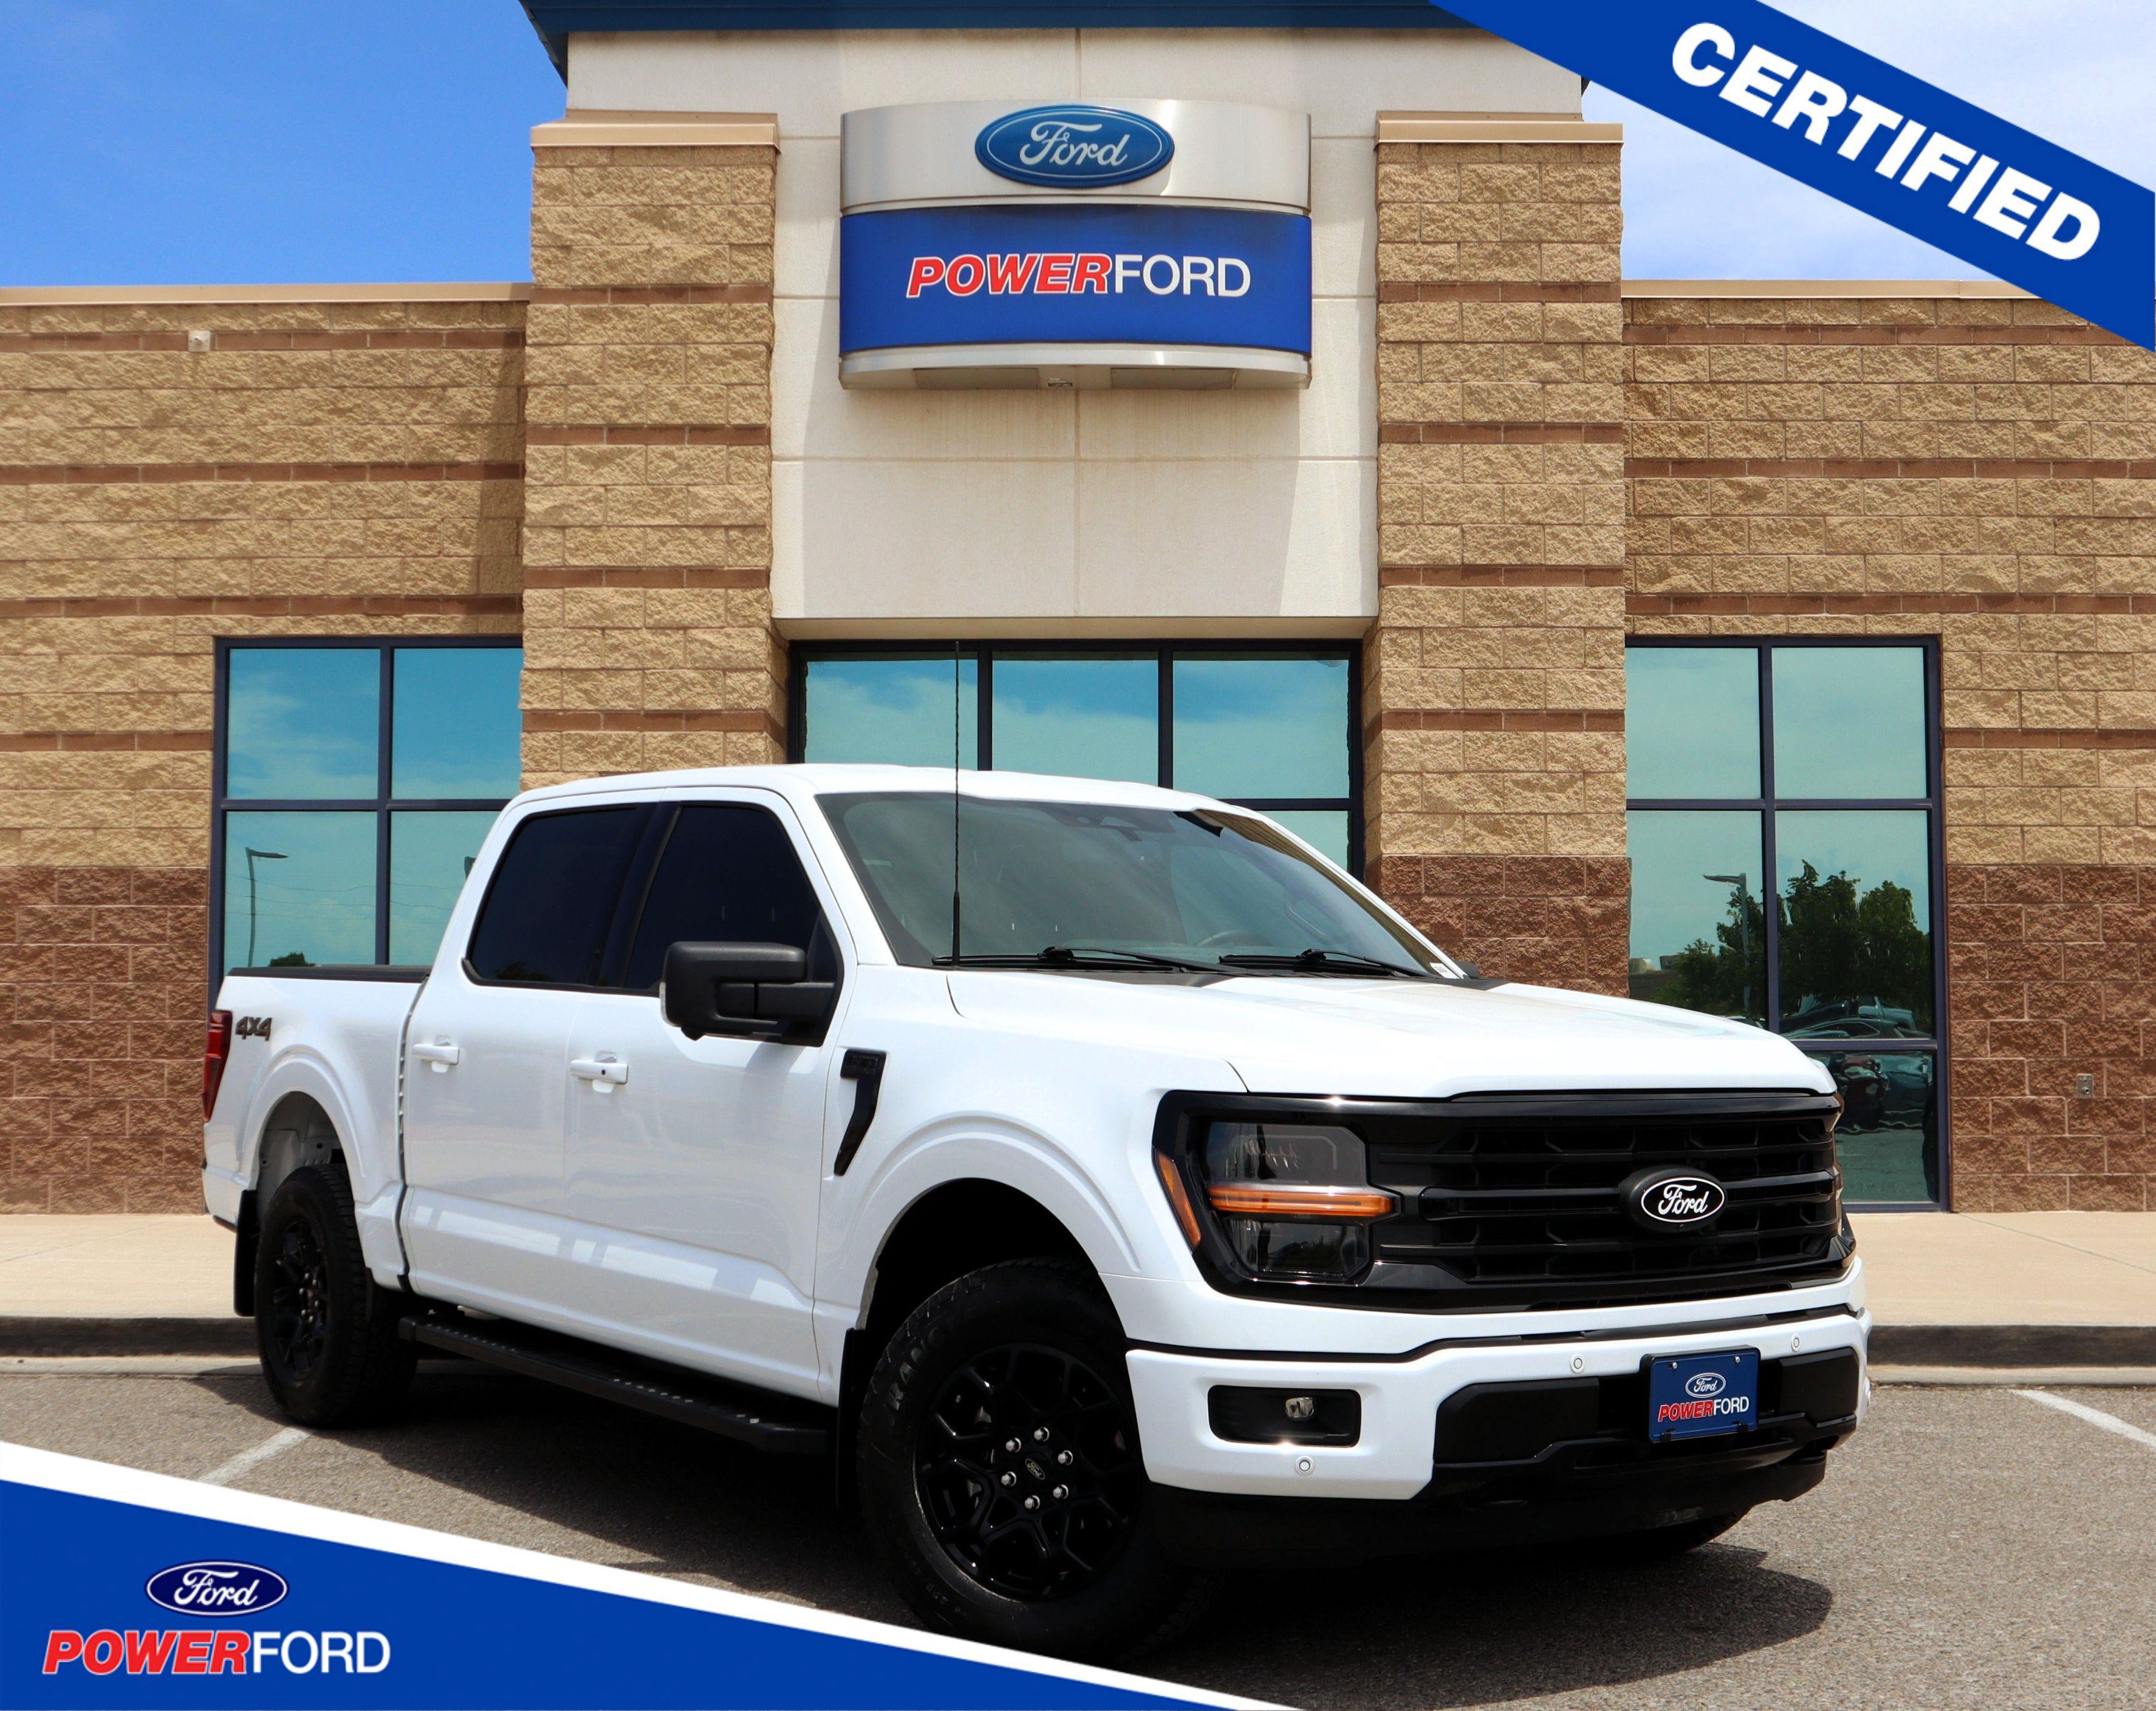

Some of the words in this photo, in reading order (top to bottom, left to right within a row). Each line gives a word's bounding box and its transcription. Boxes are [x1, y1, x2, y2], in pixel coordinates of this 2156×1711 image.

[1020, 120, 1128, 166] Ford
[1658, 1184, 1709, 1215] Ford
[1693, 1377, 1718, 1392] Ford
[1027, 1462, 1042, 1477] Ford
